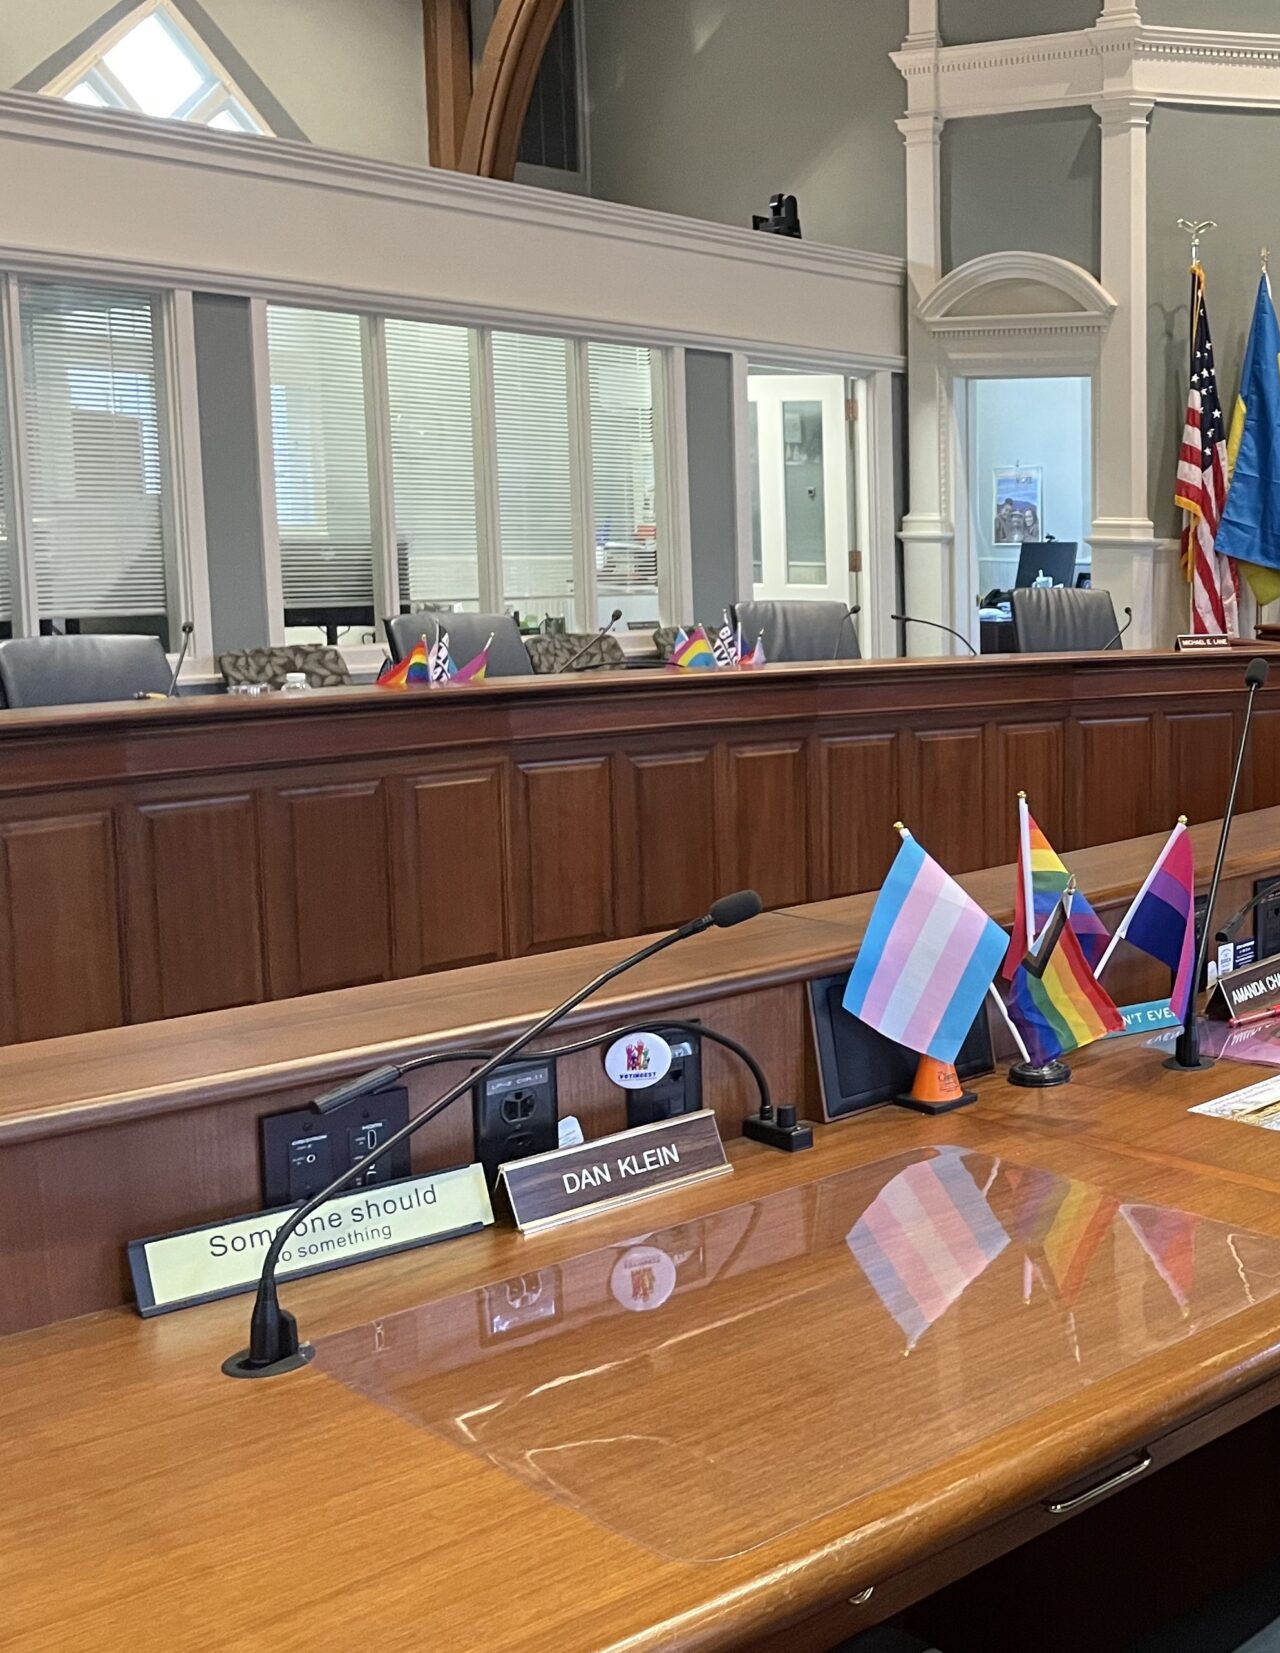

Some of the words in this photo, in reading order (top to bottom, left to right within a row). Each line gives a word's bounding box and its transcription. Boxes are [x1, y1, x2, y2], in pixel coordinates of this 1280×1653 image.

[1231, 980, 1268, 1005] AMANDA
[1121, 1011, 1143, 1026] N'T
[1146, 1006, 1176, 1022] EVE
[562, 1165, 612, 1194] DAN
[617, 1143, 680, 1179] KLEIN
[351, 1183, 438, 1223] should
[297, 1224, 393, 1258] something
